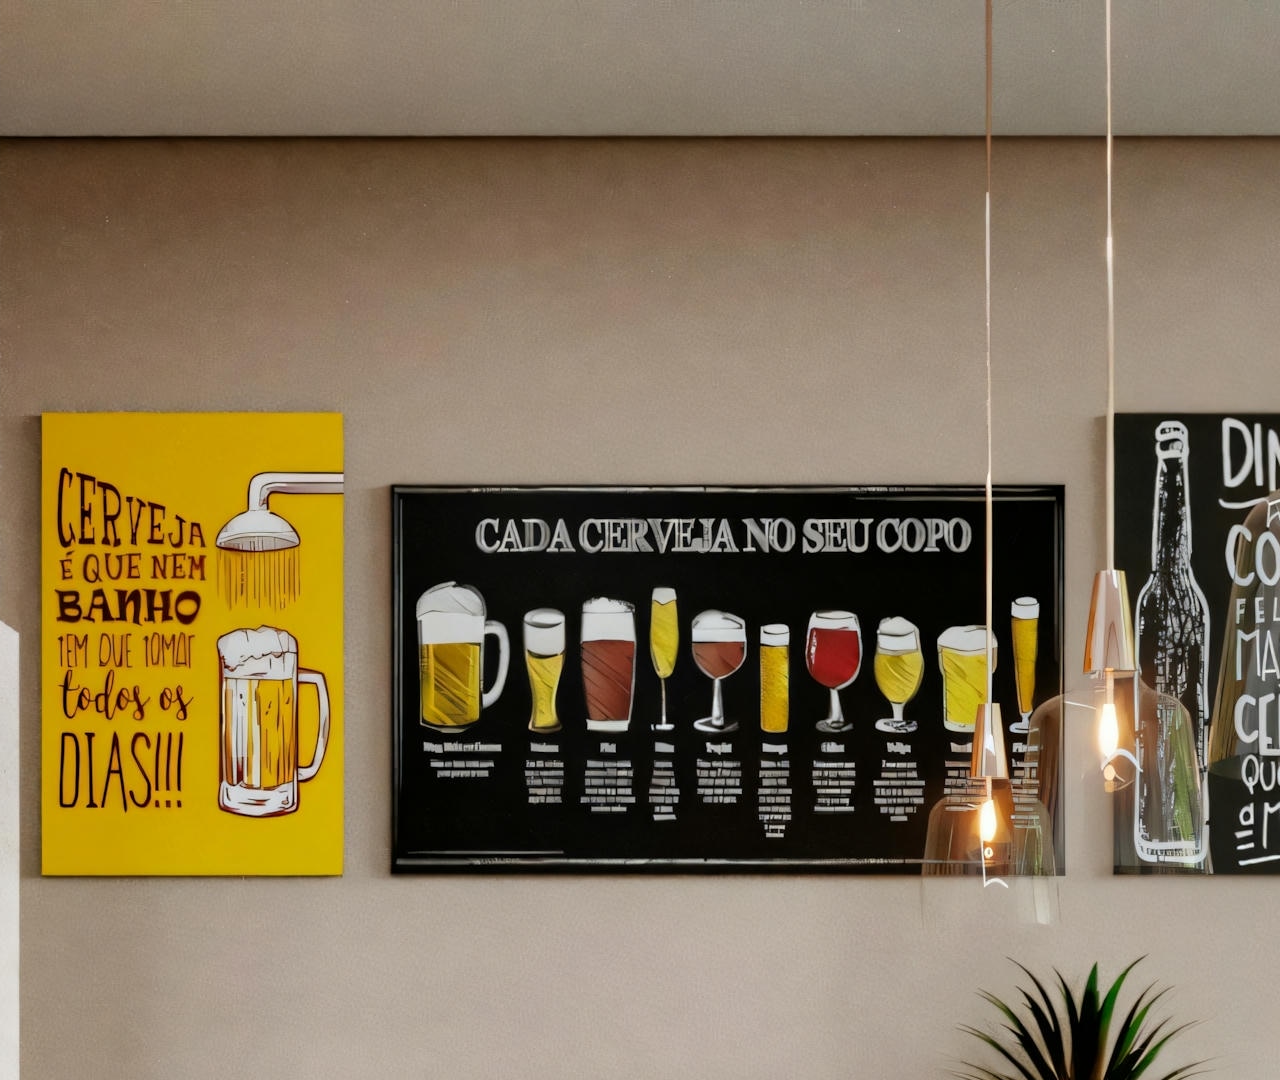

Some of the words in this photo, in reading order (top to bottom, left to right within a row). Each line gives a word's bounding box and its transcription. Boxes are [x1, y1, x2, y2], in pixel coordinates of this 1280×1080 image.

[57, 467, 206, 548] CERVEJA
[475, 518, 576, 553] CADA
[578, 518, 740, 554] CERVEJA
[741, 518, 796, 553] NO
[802, 518, 874, 553] SEU
[876, 517, 972, 553] COPO
[60, 551, 75, 580] É
[82, 553, 142, 583] QUE
[150, 553, 207, 581] NEM
[55, 588, 202, 626] BANHO
[58, 669, 151, 721] todos
[159, 685, 194, 721] os
[59, 731, 184, 813] DIAS!!!
